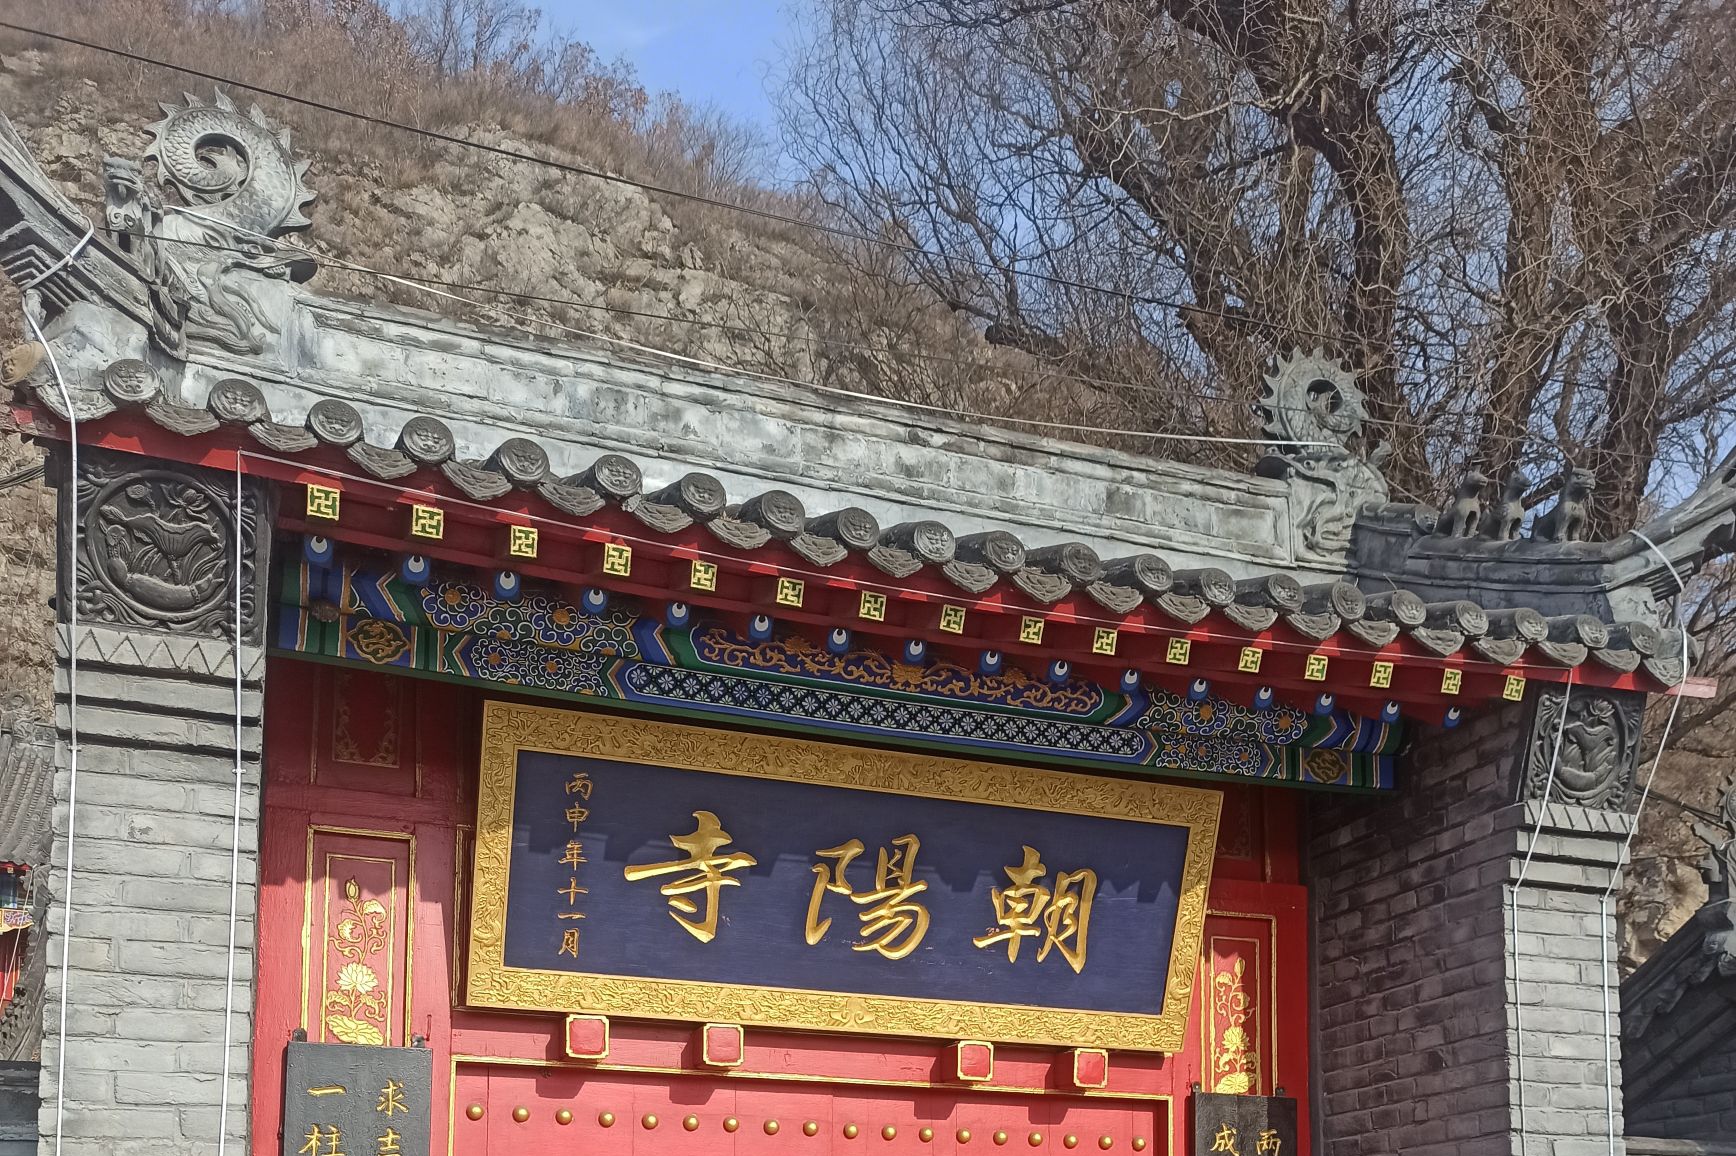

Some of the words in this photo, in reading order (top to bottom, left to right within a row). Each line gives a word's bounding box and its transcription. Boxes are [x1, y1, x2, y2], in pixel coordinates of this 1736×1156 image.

[557, 772, 594, 959] 丙申年十一月
